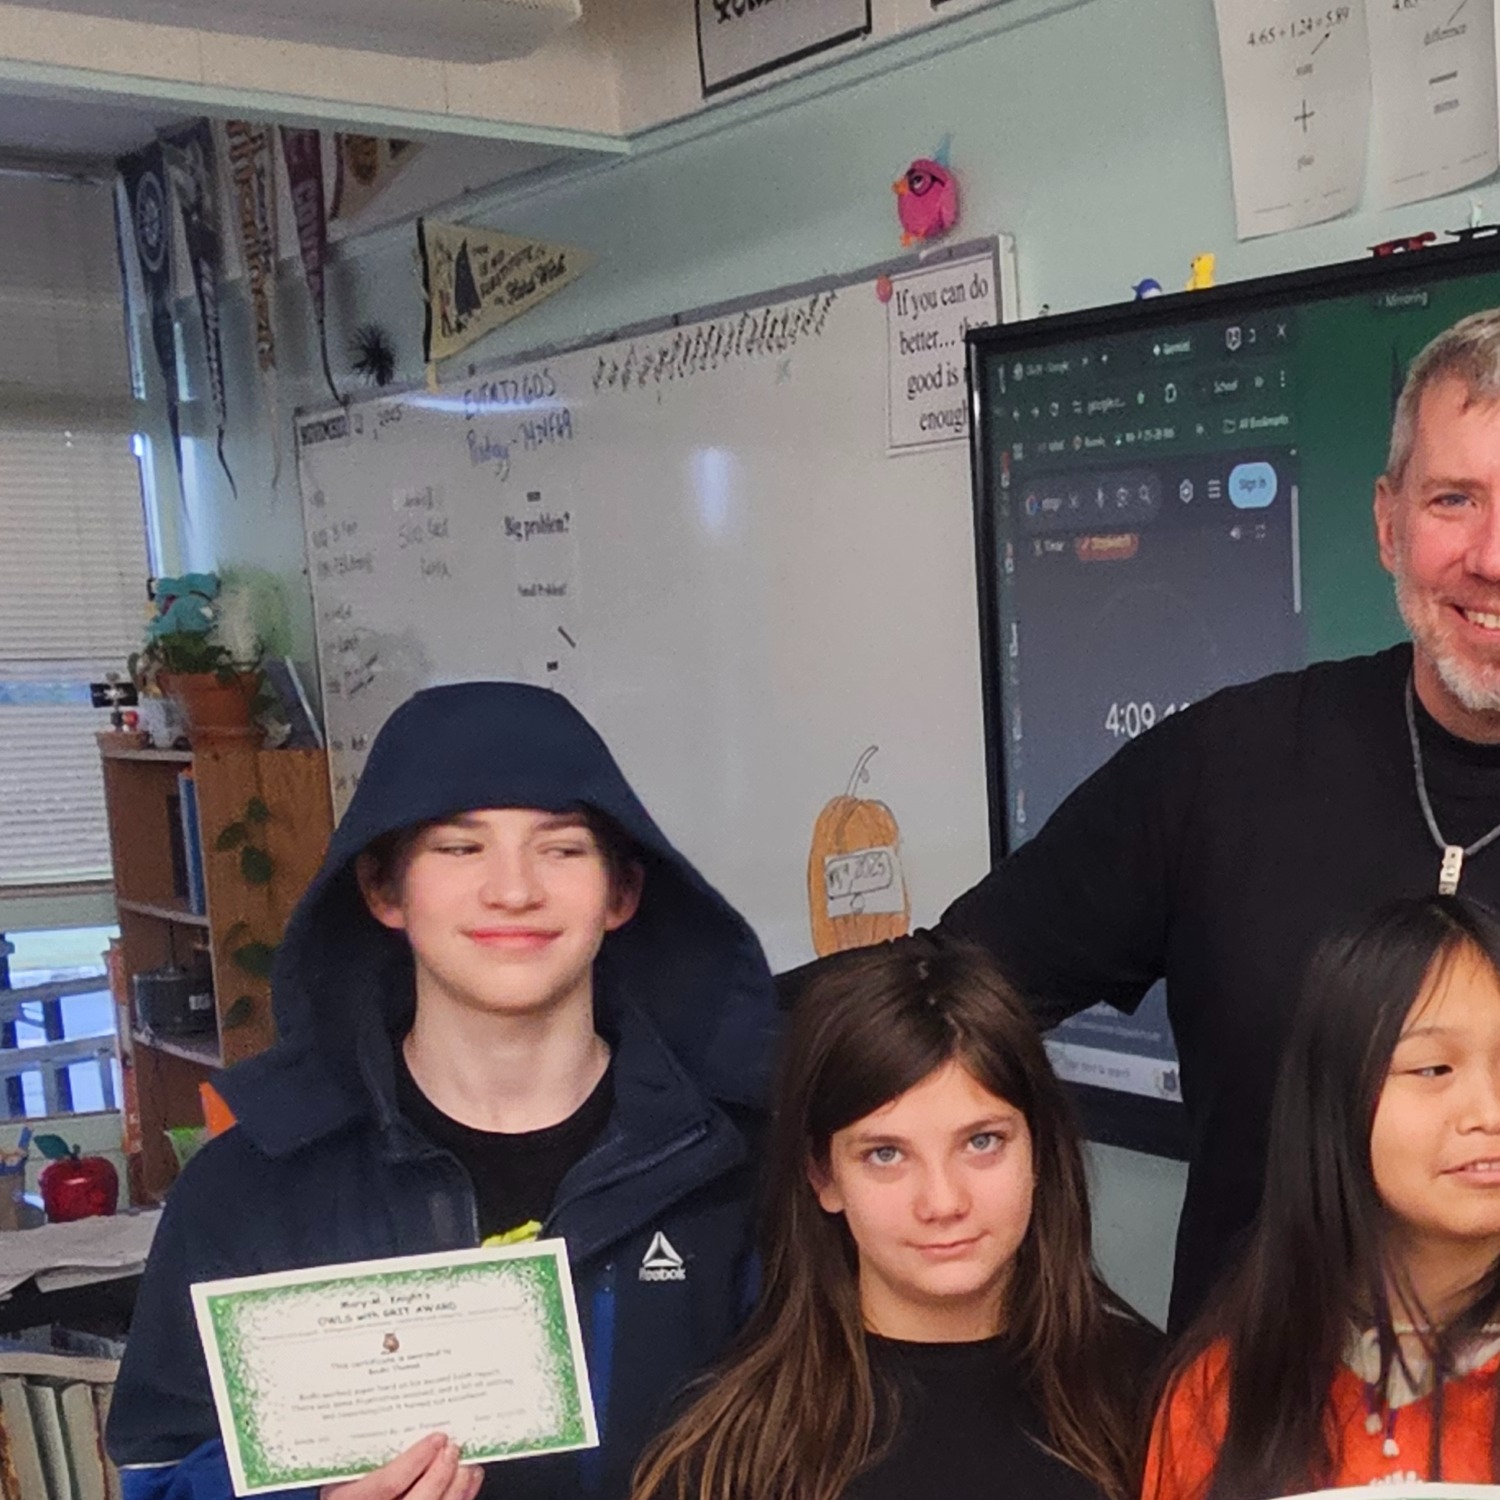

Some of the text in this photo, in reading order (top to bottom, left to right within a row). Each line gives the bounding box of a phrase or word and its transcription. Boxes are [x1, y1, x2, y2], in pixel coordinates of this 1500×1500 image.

[896, 273, 989, 320] If you can do
[907, 362, 959, 401] good is
[316, 1299, 457, 1327] OWLS with GRIT AWARD
